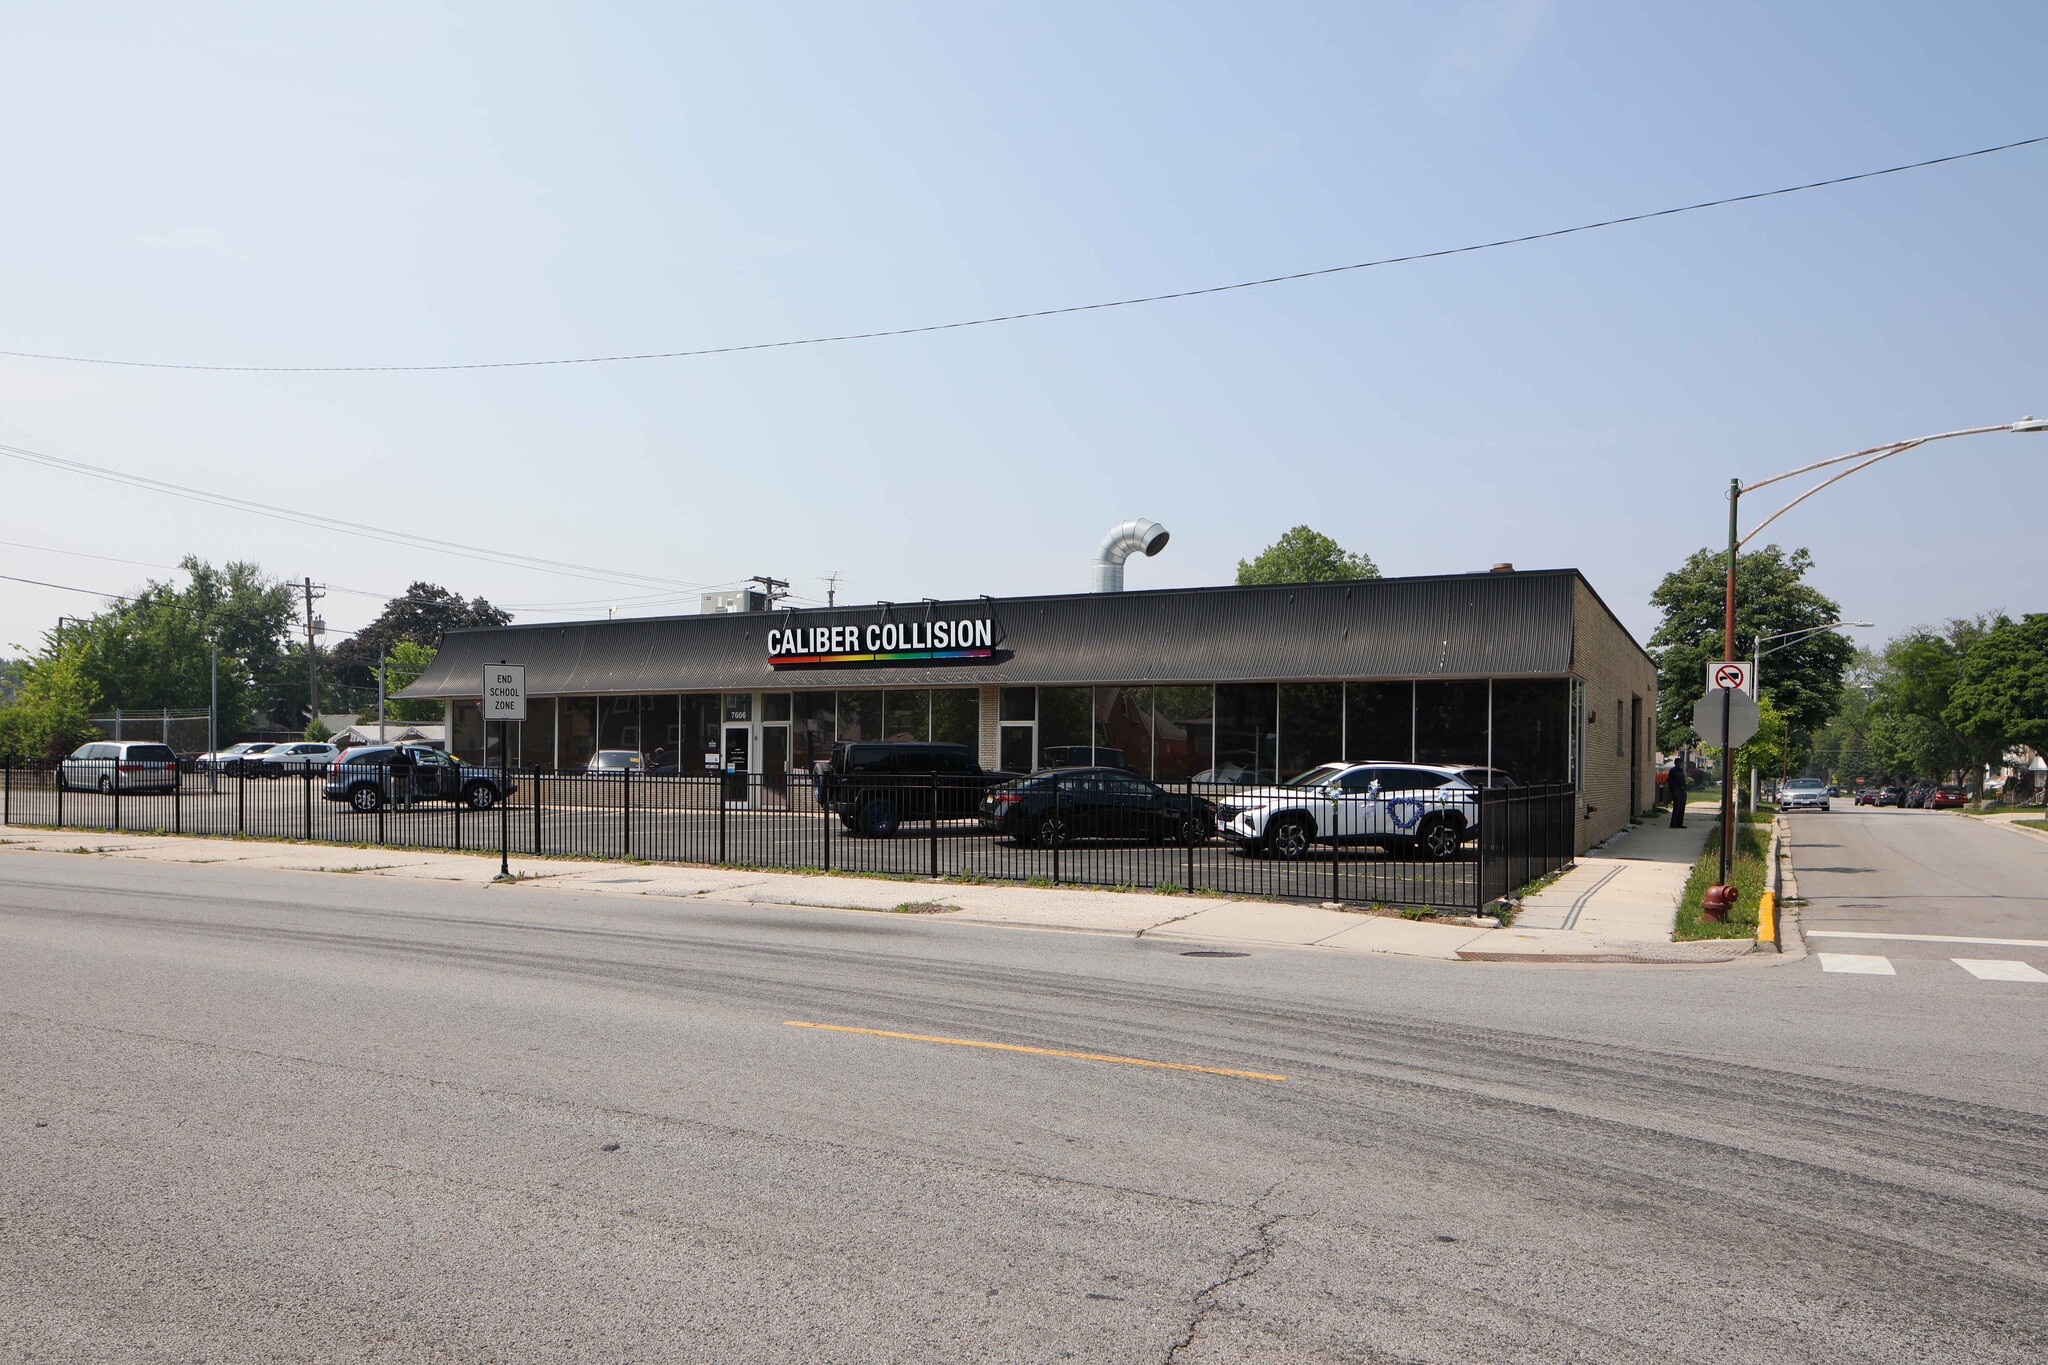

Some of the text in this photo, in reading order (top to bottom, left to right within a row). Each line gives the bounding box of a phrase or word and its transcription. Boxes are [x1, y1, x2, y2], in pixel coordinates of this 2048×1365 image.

[767, 618, 992, 654] CALIBER COLLISION
[497, 674, 512, 684] END
[490, 687, 520, 697] SCHOOL
[495, 700, 515, 710] ZONE
